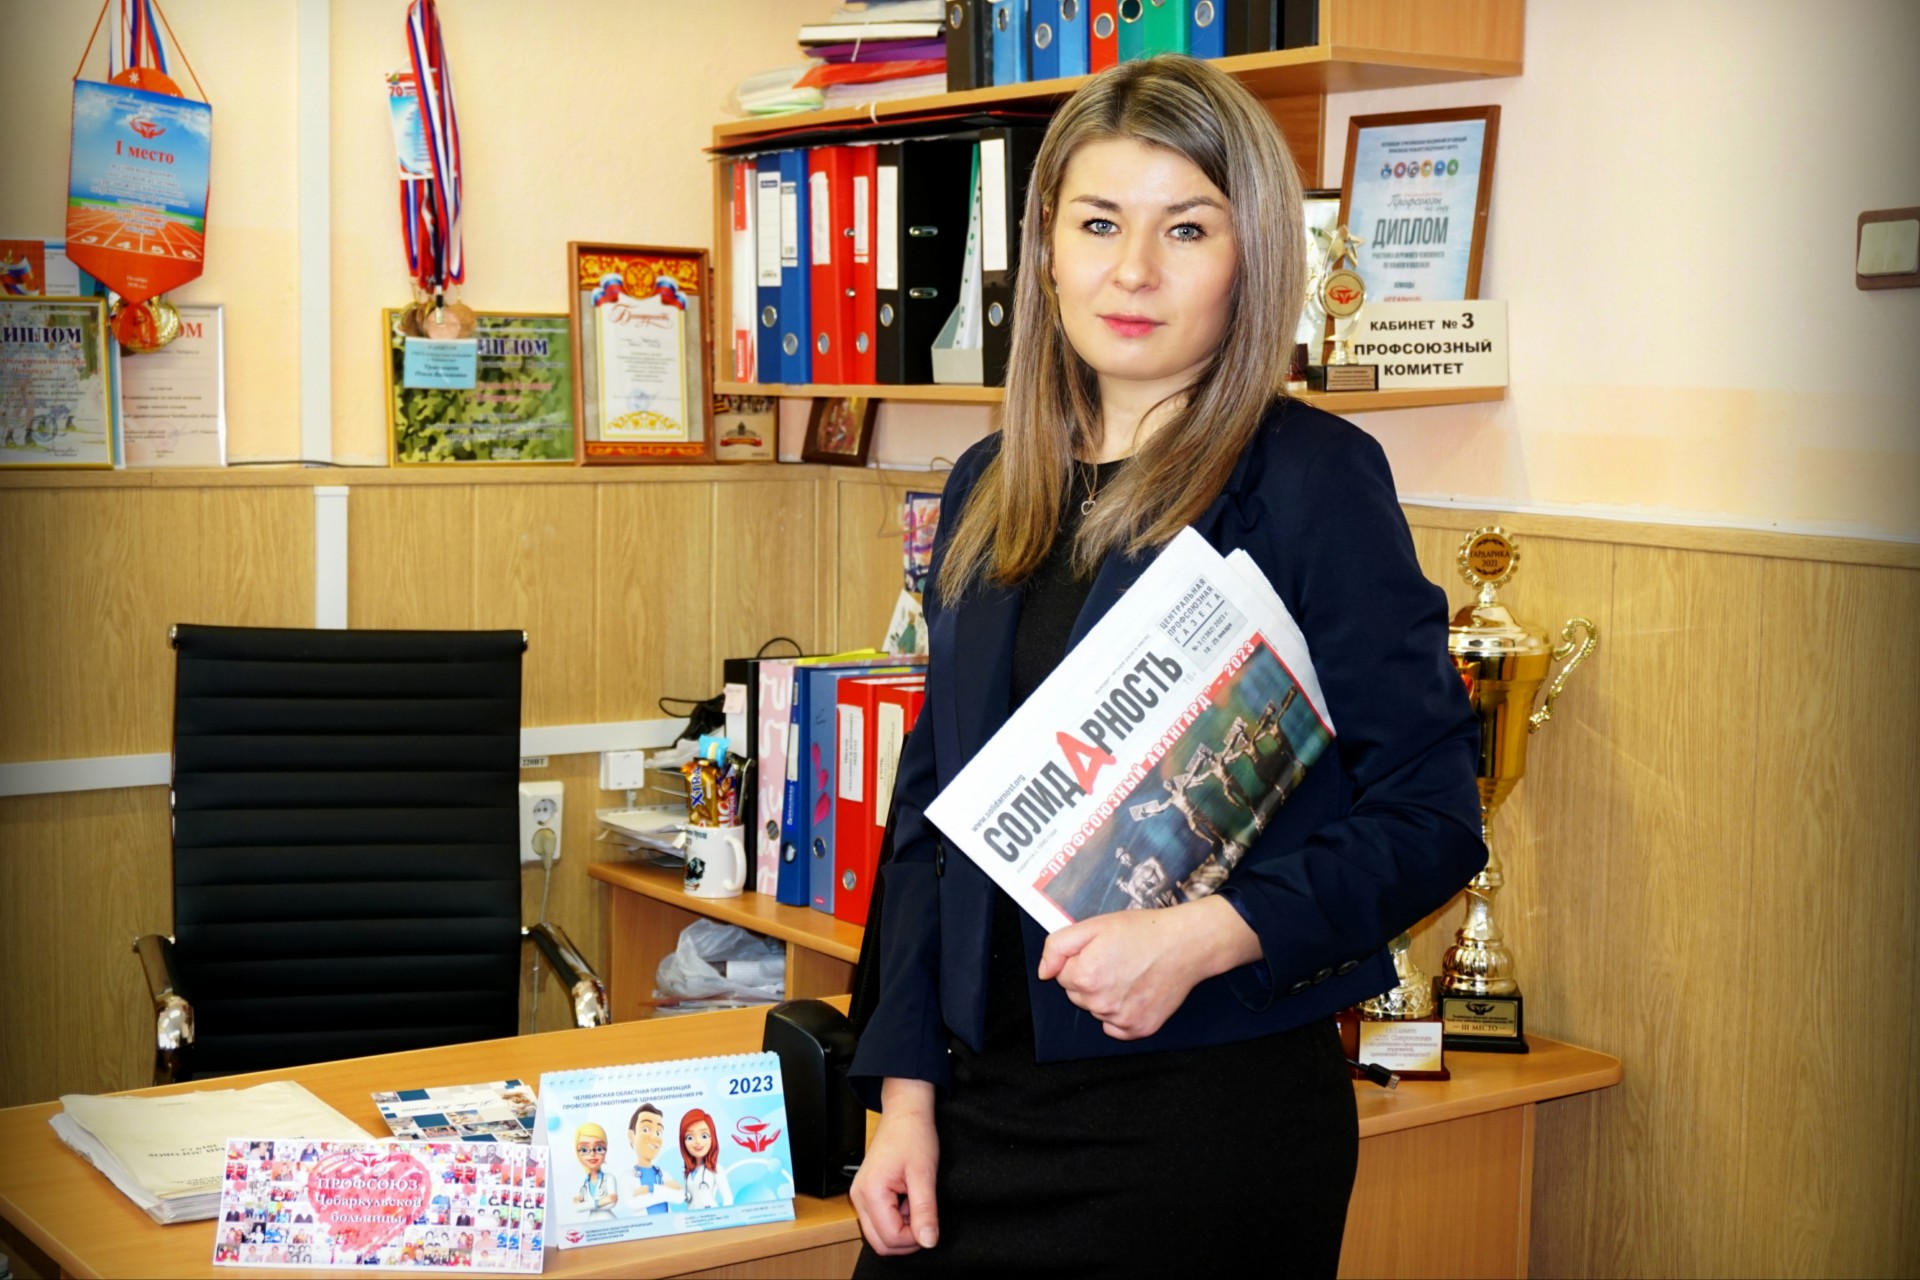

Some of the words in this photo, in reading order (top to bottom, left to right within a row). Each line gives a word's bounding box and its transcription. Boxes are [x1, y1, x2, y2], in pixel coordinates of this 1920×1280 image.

[128, 146, 175, 165] место
[1372, 217, 1449, 248] ДИПЛОМ
[1370, 320, 1436, 331] КАБИНЕТ
[1442, 319, 1457, 329] №
[1462, 312, 1474, 329] 3
[0, 327, 82, 344] ИПЛОМ
[477, 339, 550, 356] ИПЛОМ
[1354, 338, 1492, 356] ПРОФСОЮЗНЫЙ
[1384, 363, 1463, 376] КОМИТЕТ
[1470, 550, 1510, 559] ГАРДАРИКА
[1482, 559, 1498, 568] 2021
[1159, 578, 1206, 629] ЦЕНТРАЛЬНАЯ
[1167, 585, 1213, 636] ПРОФСОЮЗНАЯ
[1211, 637, 1219, 645] 25
[1223, 640, 1255, 677] 2023
[983, 651, 1183, 862] СОЛИДАРНОСТЬ
[971, 774, 1026, 833] www.solidarnost.org
[1472, 1024, 1498, 1032] МЕСТО
[573, 1091, 614, 1101] ЧЕЛЯБИНСКАЯ
[615, 1087, 648, 1098] ОБЛАСТНАЯ
[649, 1084, 692, 1095] ОРГАНИЗАЦИЯ
[728, 1075, 774, 1096] 2023
[562, 1100, 600, 1110] ПРОФСОЮЗА
[601, 1097, 638, 1107] РАБОТНИКОВ
[639, 1092, 695, 1103] ЗДРАВООХРАНЕНИЯ
[317, 1177, 419, 1191] ПРОФСОЮЗ
[315, 1196, 423, 1209] Чебаркульской
[330, 1212, 405, 1225] больницы
